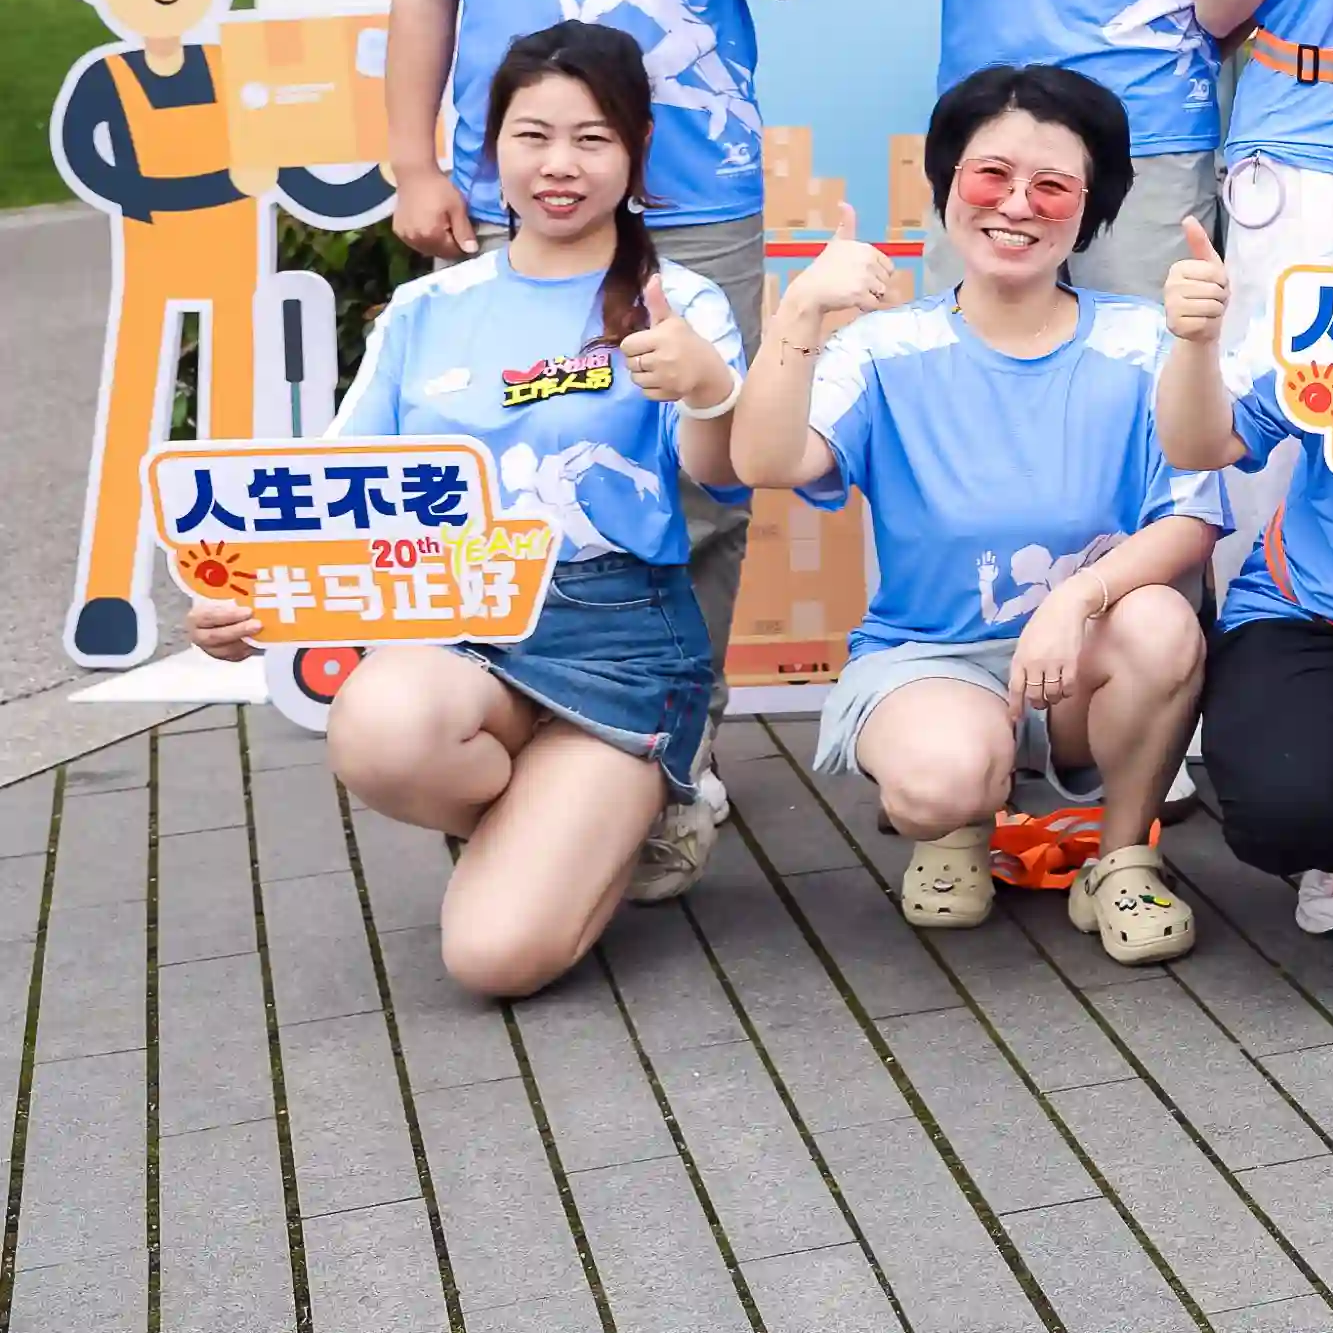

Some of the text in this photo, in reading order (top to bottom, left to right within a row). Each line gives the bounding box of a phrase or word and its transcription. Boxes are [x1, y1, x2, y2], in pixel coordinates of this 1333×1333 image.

[176, 464, 470, 534] 人生不老
[371, 536, 440, 568] 20th
[254, 564, 521, 624] 半马正好
